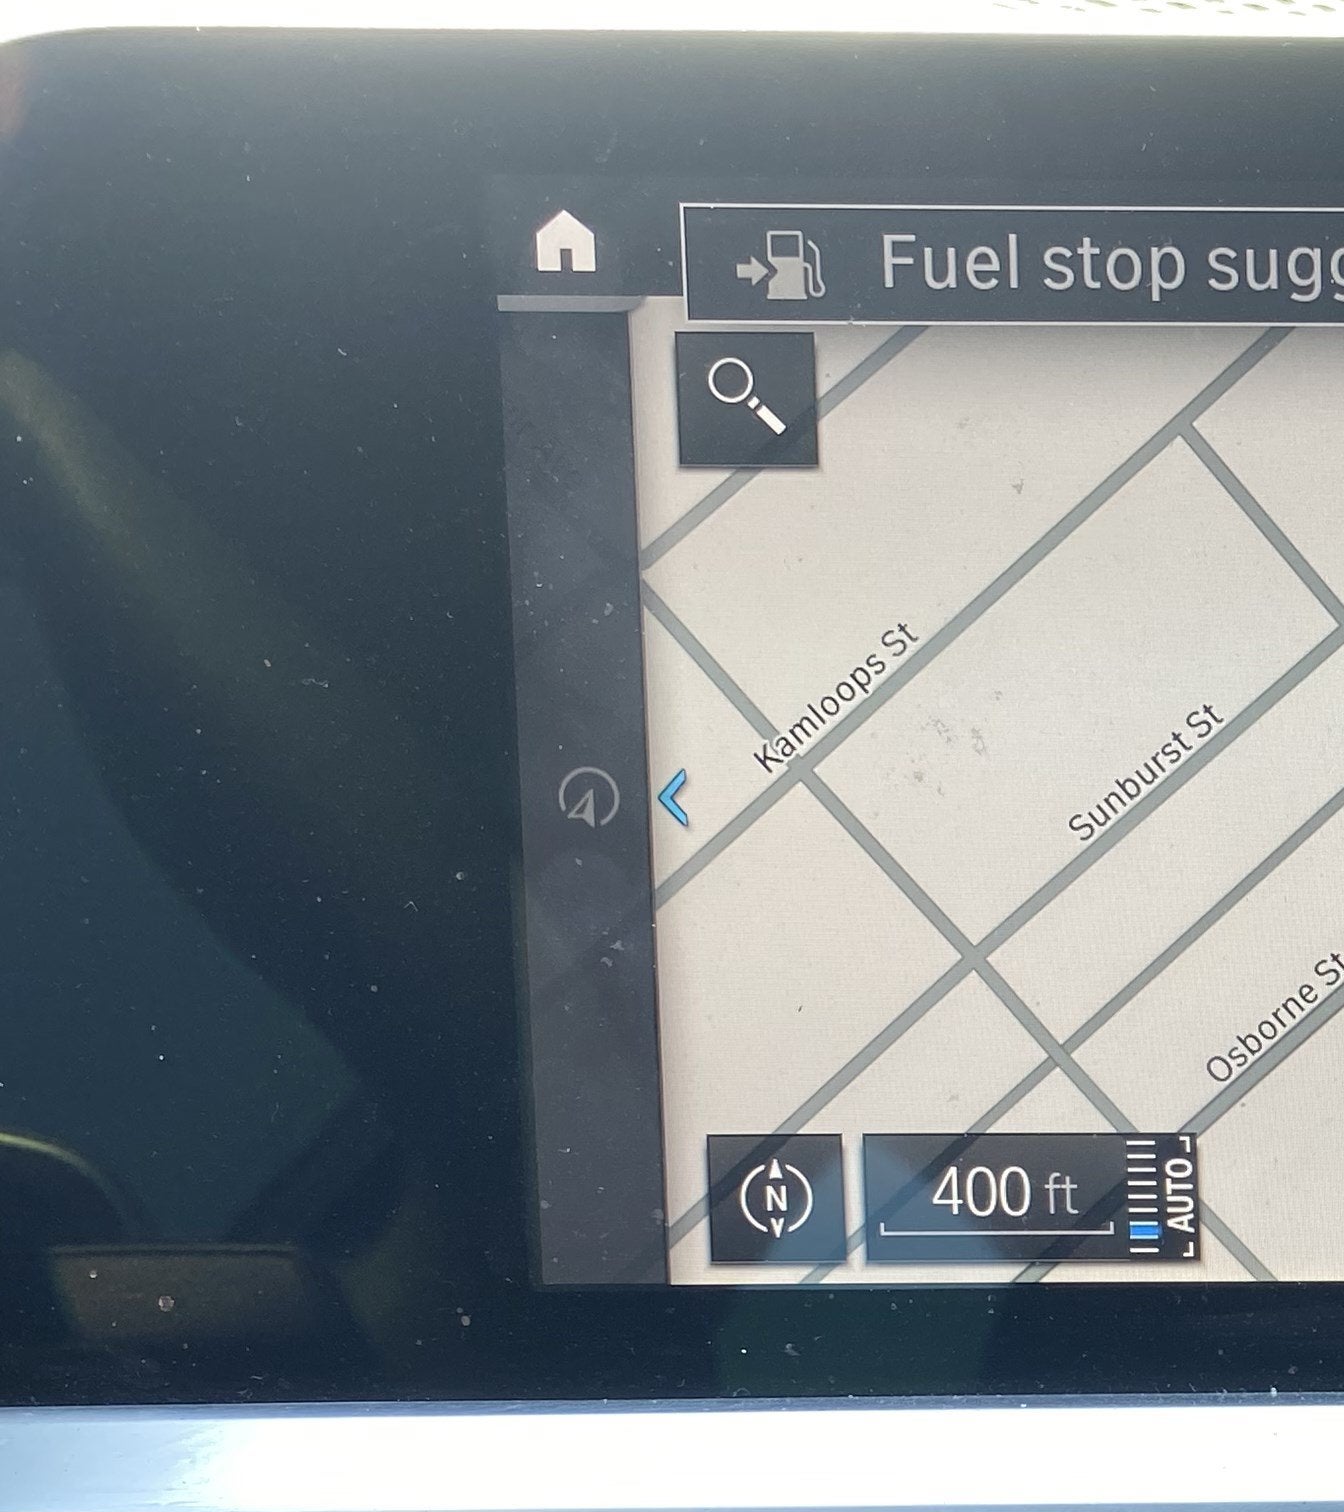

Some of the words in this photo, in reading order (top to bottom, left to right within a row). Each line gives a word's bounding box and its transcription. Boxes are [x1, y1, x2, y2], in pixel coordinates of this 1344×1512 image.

[882, 233, 1018, 290] Fuel
[1043, 236, 1185, 302] stop
[753, 653, 887, 773] Kamloops
[881, 622, 919, 657] St
[1068, 731, 1193, 841] Sunburst
[1185, 704, 1224, 739] St
[1206, 983, 1318, 1082] Osborne
[766, 1185, 788, 1212] N
[932, 1166, 1031, 1217] 400
[1044, 1172, 1079, 1215] ft
[1165, 1158, 1195, 1233] AUTO
